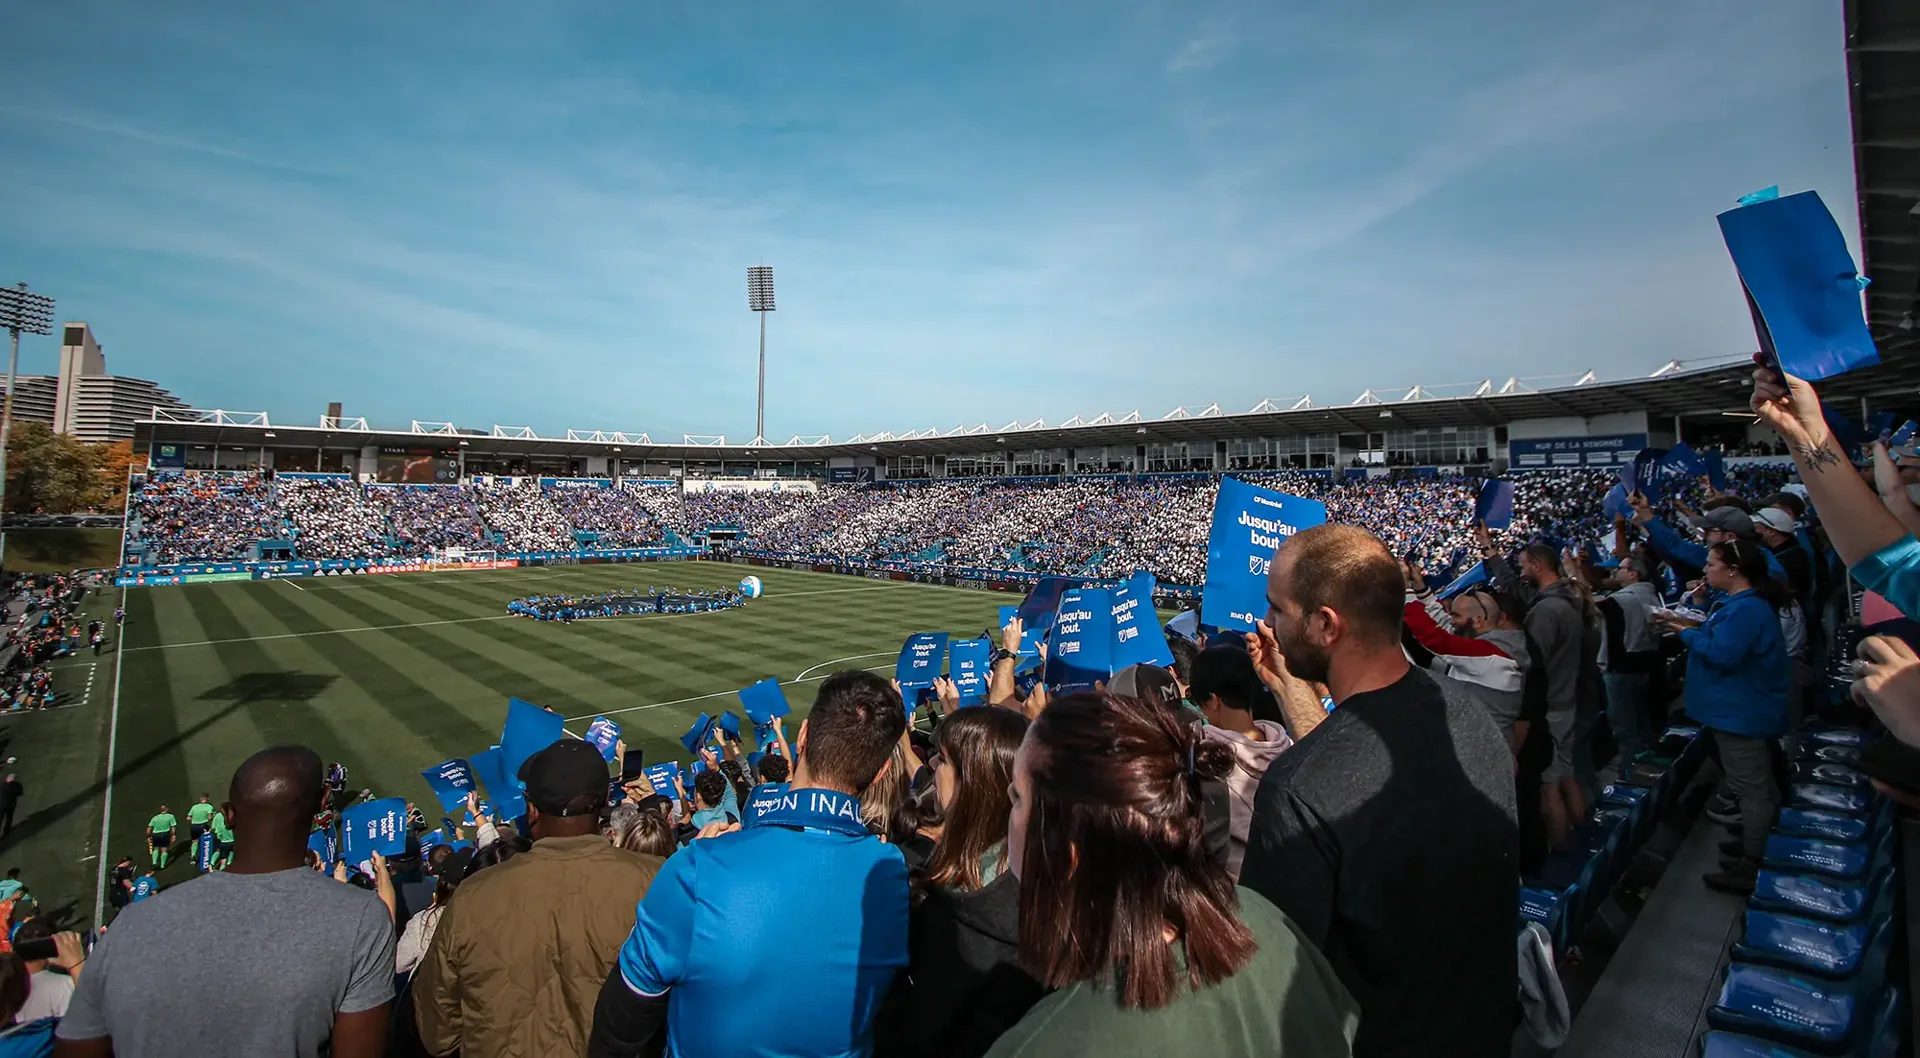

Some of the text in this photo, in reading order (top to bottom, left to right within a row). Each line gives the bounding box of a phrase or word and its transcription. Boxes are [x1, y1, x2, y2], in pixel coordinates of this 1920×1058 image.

[1535, 442, 1552, 450] MUR
[1238, 510, 1297, 536] Jusqu'au
[1061, 622, 1081, 635] bout.
